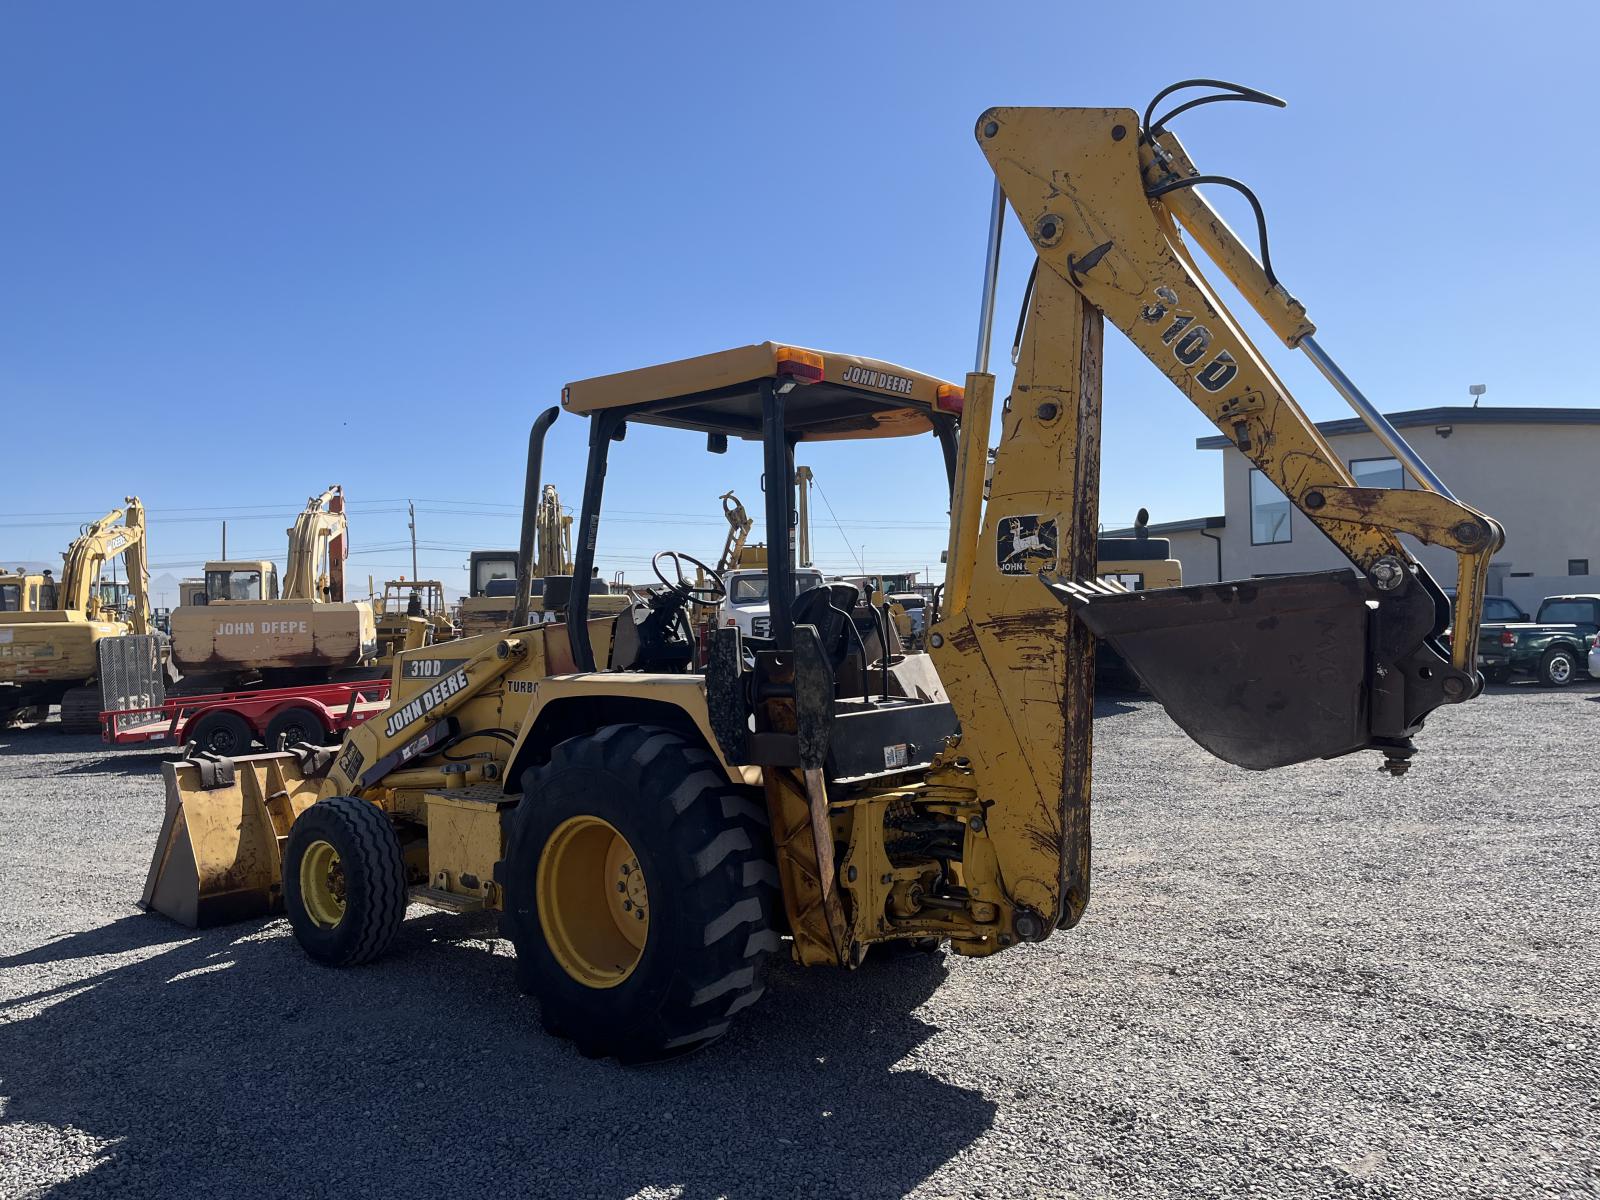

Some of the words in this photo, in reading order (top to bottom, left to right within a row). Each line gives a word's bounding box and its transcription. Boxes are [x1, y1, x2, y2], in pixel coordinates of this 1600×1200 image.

[1140, 285, 1239, 393] 310D
[843, 365, 878, 387] JOHN
[878, 372, 913, 394] DEERE
[1000, 562, 1023, 571] JOHN
[215, 622, 255, 635] JOHN
[386, 699, 423, 737] JOHN
[422, 669, 467, 711] DEERE
